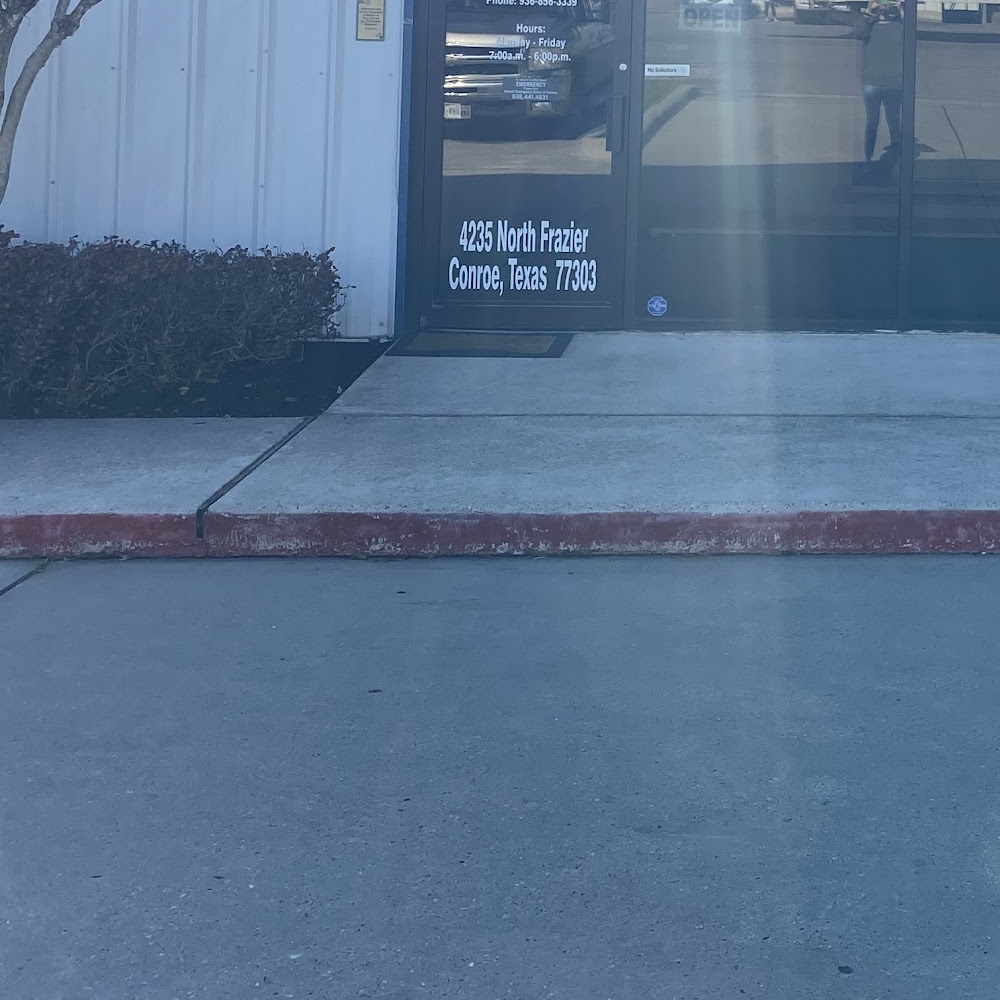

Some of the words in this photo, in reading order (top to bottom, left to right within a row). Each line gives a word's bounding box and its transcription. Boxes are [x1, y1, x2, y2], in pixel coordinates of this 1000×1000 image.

[684, 8, 739, 28] OPEN
[516, 23, 546, 34] Hours:
[496, 37, 530, 49] Monday
[538, 38, 566, 50] Friday
[459, 220, 493, 252] 4235
[497, 220, 535, 253] North
[540, 220, 589, 253] Frazier
[449, 256, 504, 296] Conroe,
[508, 258, 548, 291] Texas
[555, 259, 597, 292] 77303
